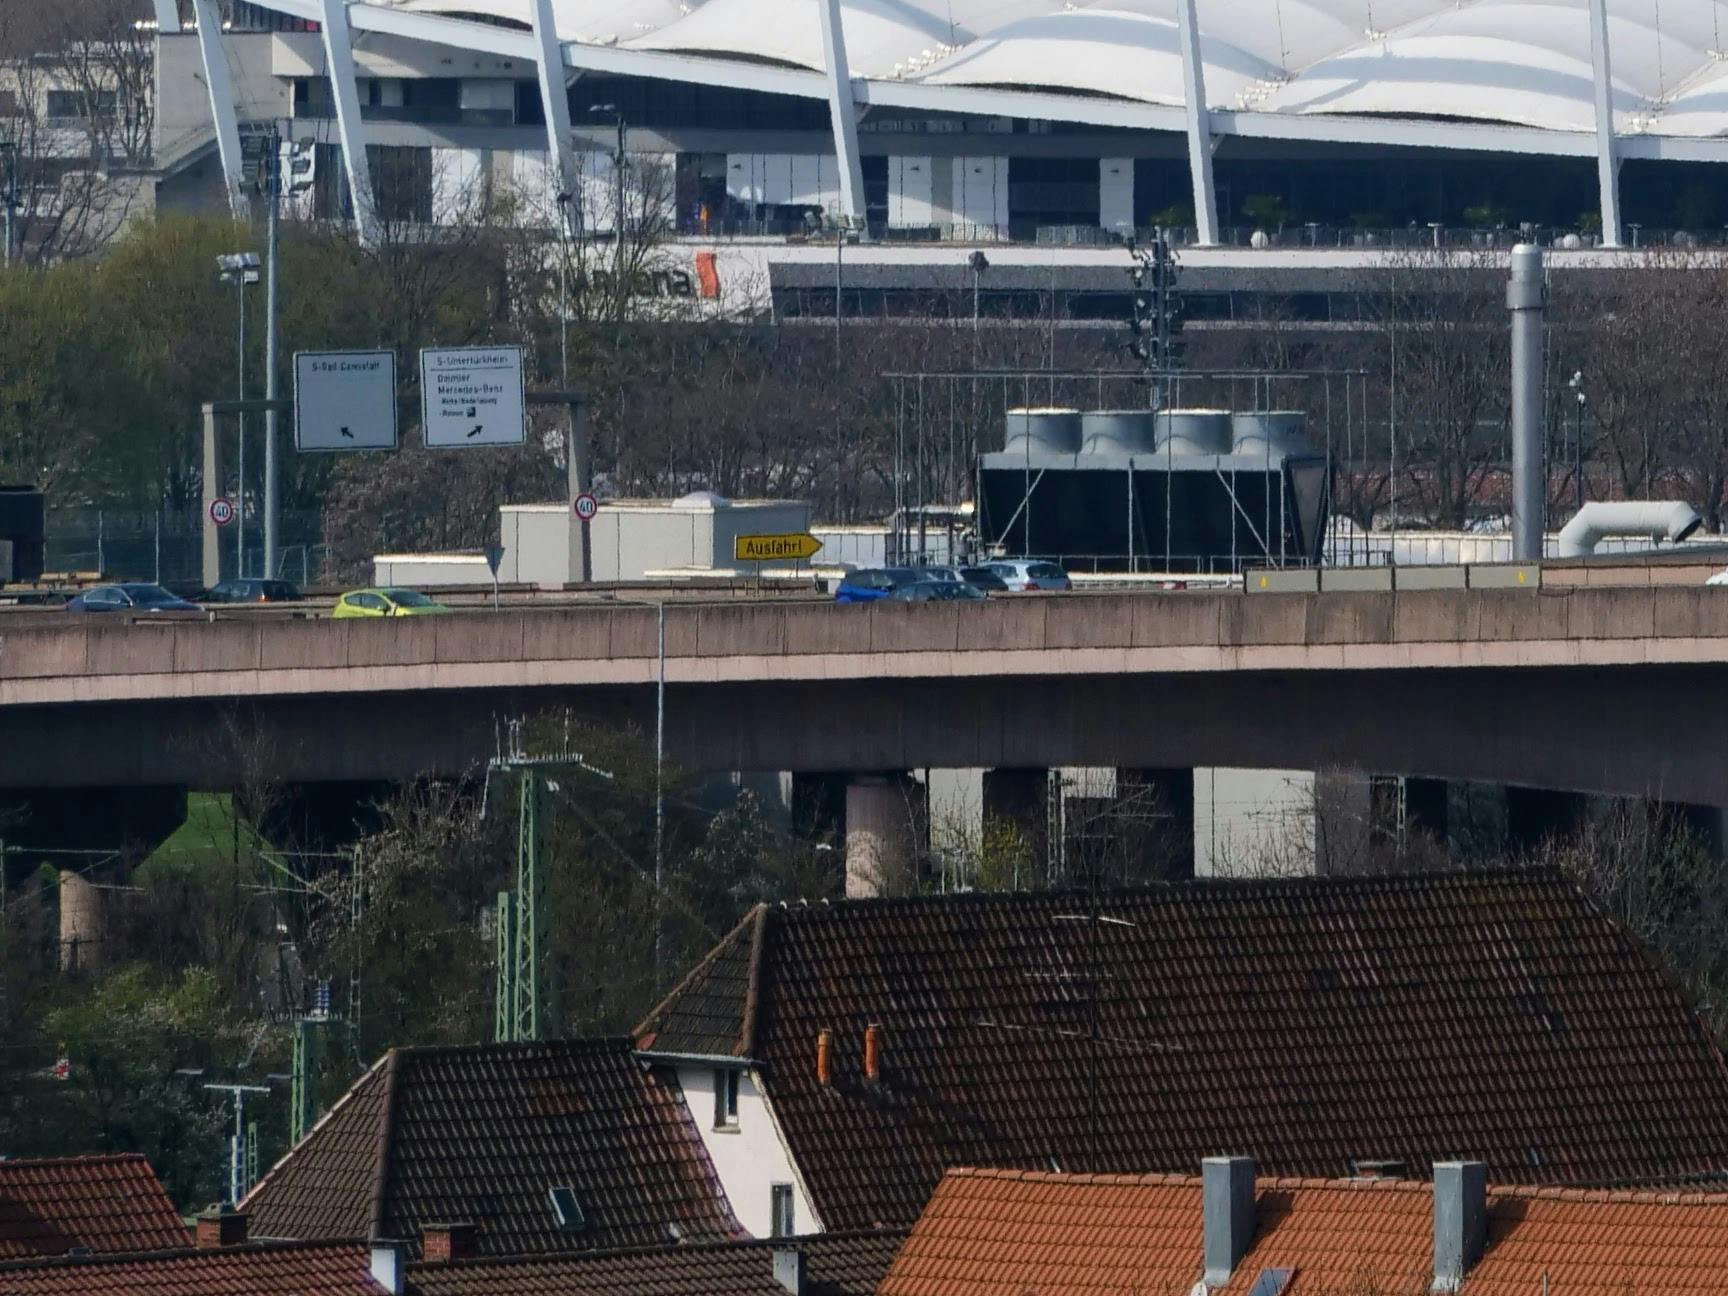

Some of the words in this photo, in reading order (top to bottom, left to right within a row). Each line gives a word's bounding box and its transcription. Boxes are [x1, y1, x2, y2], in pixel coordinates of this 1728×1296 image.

[215, 505, 229, 518] 40
[579, 501, 593, 514] 40
[746, 538, 802, 555] Ausfahrt
